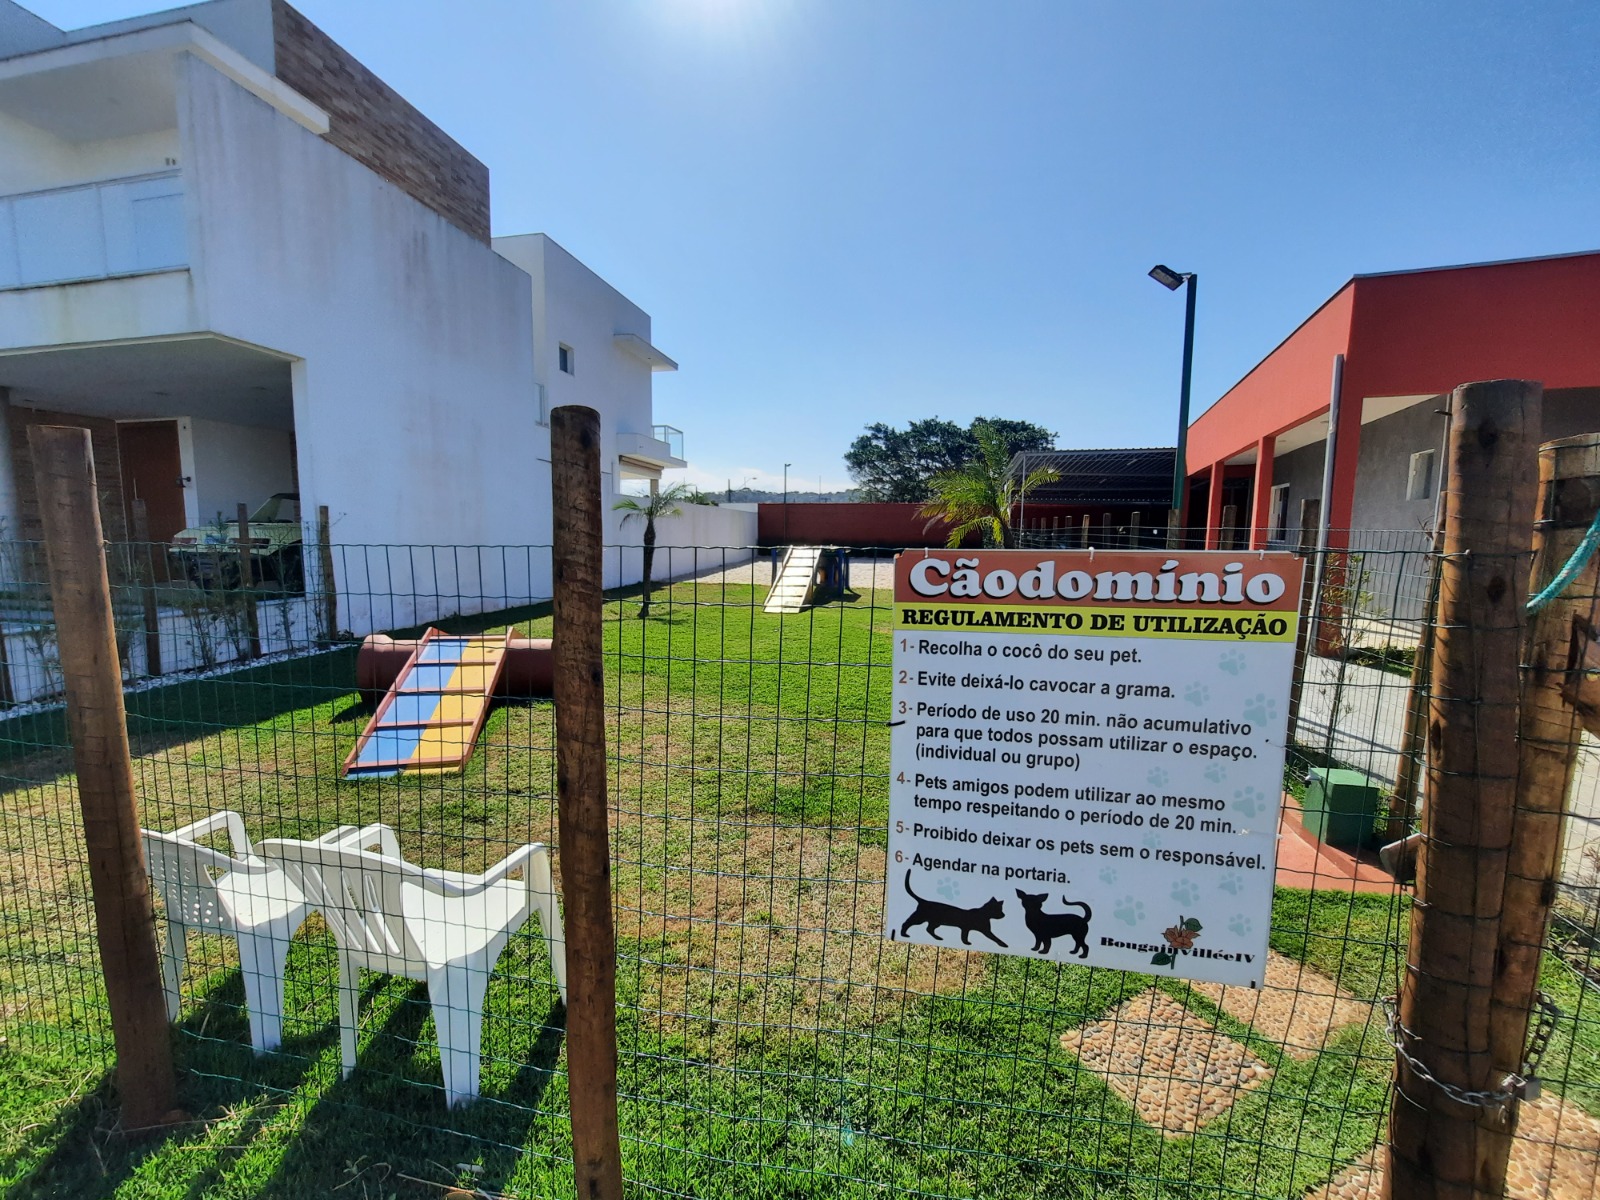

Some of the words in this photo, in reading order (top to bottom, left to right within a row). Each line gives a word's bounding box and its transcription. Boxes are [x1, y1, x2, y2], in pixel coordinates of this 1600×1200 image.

[909, 557, 1286, 603] Cãodomínio
[901, 608, 1083, 629] REGULAMENTO
[1089, 613, 1124, 630] DE
[1132, 613, 1287, 639] UTILIZAÇÃO
[918, 639, 982, 656] Recolha
[987, 645, 997, 656] o
[1002, 643, 1042, 658] cocô
[1047, 644, 1068, 659] do
[1073, 648, 1104, 661] seu
[1109, 648, 1141, 665] pet.
[917, 670, 955, 686] Evite
[960, 672, 1024, 690] deixá-lo
[1029, 679, 1096, 693] cavocar
[1100, 683, 1109, 694] a
[1115, 683, 1174, 699] grama.
[916, 701, 976, 719] Período
[981, 705, 1000, 720] de
[1006, 710, 1035, 722] uso
[1040, 708, 1059, 724] 20
[1064, 710, 1099, 726] min.
[1106, 713, 1137, 728] não
[1142, 717, 1251, 735] acumulativo
[915, 742, 995, 762] (individual
[1001, 752, 1020, 763] ou
[1026, 753, 1079, 771] grupo)
[916, 725, 949, 739] para
[953, 728, 982, 742] que
[987, 727, 1032, 743] todos
[1038, 733, 1103, 748] possam
[1109, 735, 1167, 752] utilizar
[1172, 741, 1183, 753] o
[1188, 743, 1256, 761] espaço.
[914, 773, 947, 789] Pets
[952, 778, 1009, 796] amigos
[1014, 782, 1069, 799] podem
[1074, 786, 1131, 803] utilizar
[1135, 793, 1156, 805] ao
[1161, 795, 1225, 811] mesmo
[913, 794, 961, 813] tempo
[966, 801, 1059, 819] respeitando
[1064, 809, 1075, 820] o
[1080, 809, 1143, 826] período
[1149, 812, 1169, 828] de
[1174, 814, 1194, 830] 20
[1200, 817, 1236, 833] min.
[913, 822, 977, 843] Proibido
[982, 830, 1031, 848] deixar
[1035, 838, 1054, 850] os
[1060, 839, 1094, 855] pets
[1099, 844, 1133, 858] sem
[1139, 847, 1150, 859] o
[1155, 849, 1265, 869] responsável.
[912, 852, 977, 873] Agendar
[981, 864, 999, 876] na
[1004, 866, 1070, 883] portaria.
